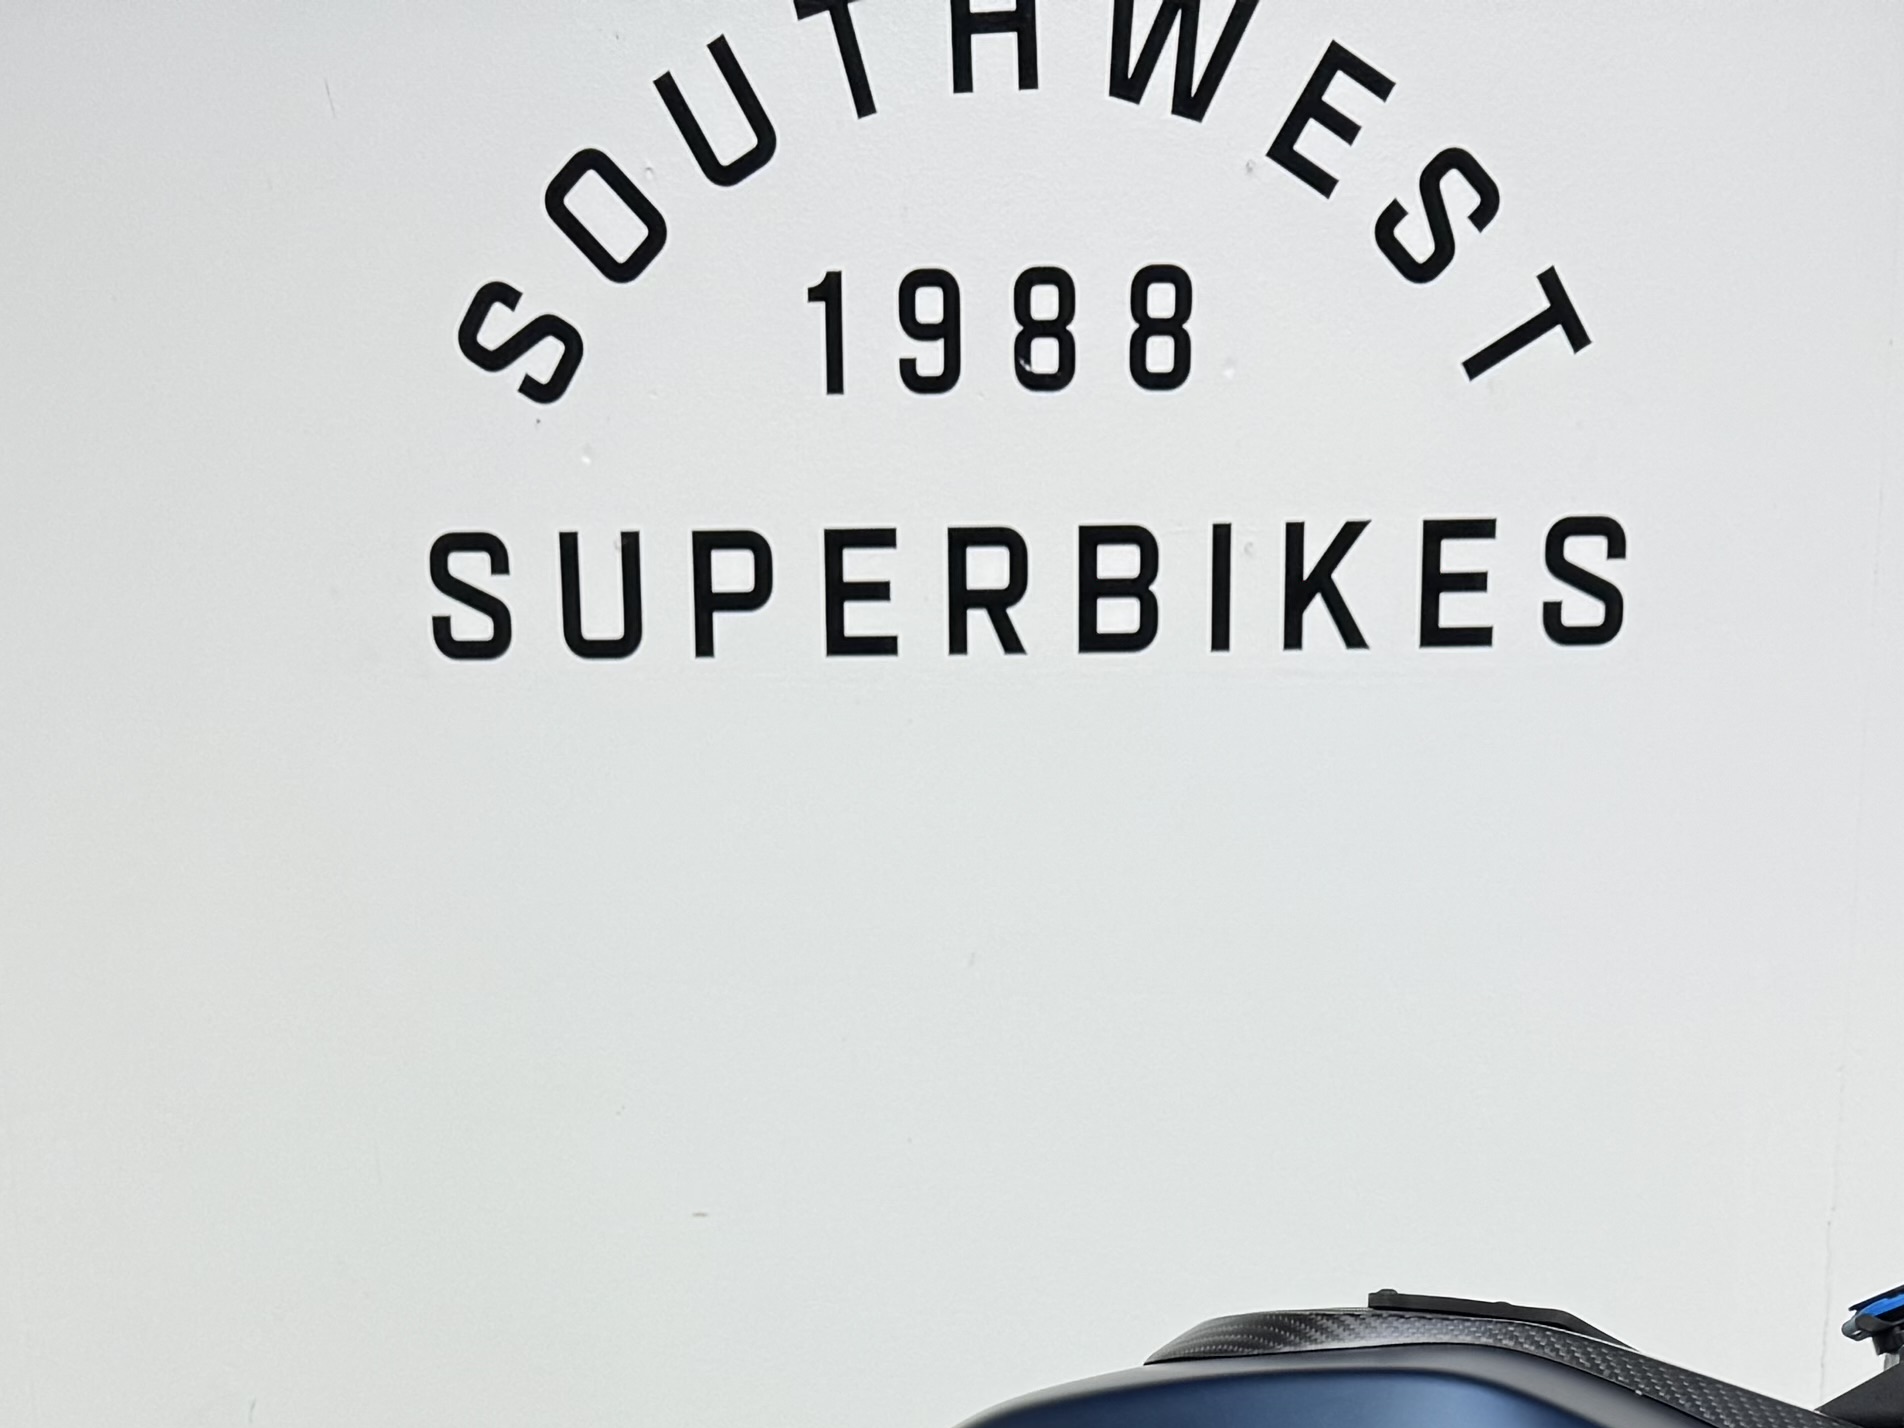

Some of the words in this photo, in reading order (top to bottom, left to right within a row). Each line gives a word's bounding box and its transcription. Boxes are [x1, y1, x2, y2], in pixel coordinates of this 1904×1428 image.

[457, 0, 1593, 406] SOUTHWEST
[805, 263, 1194, 396] 1988
[428, 515, 1628, 661] SUPERBIKES
